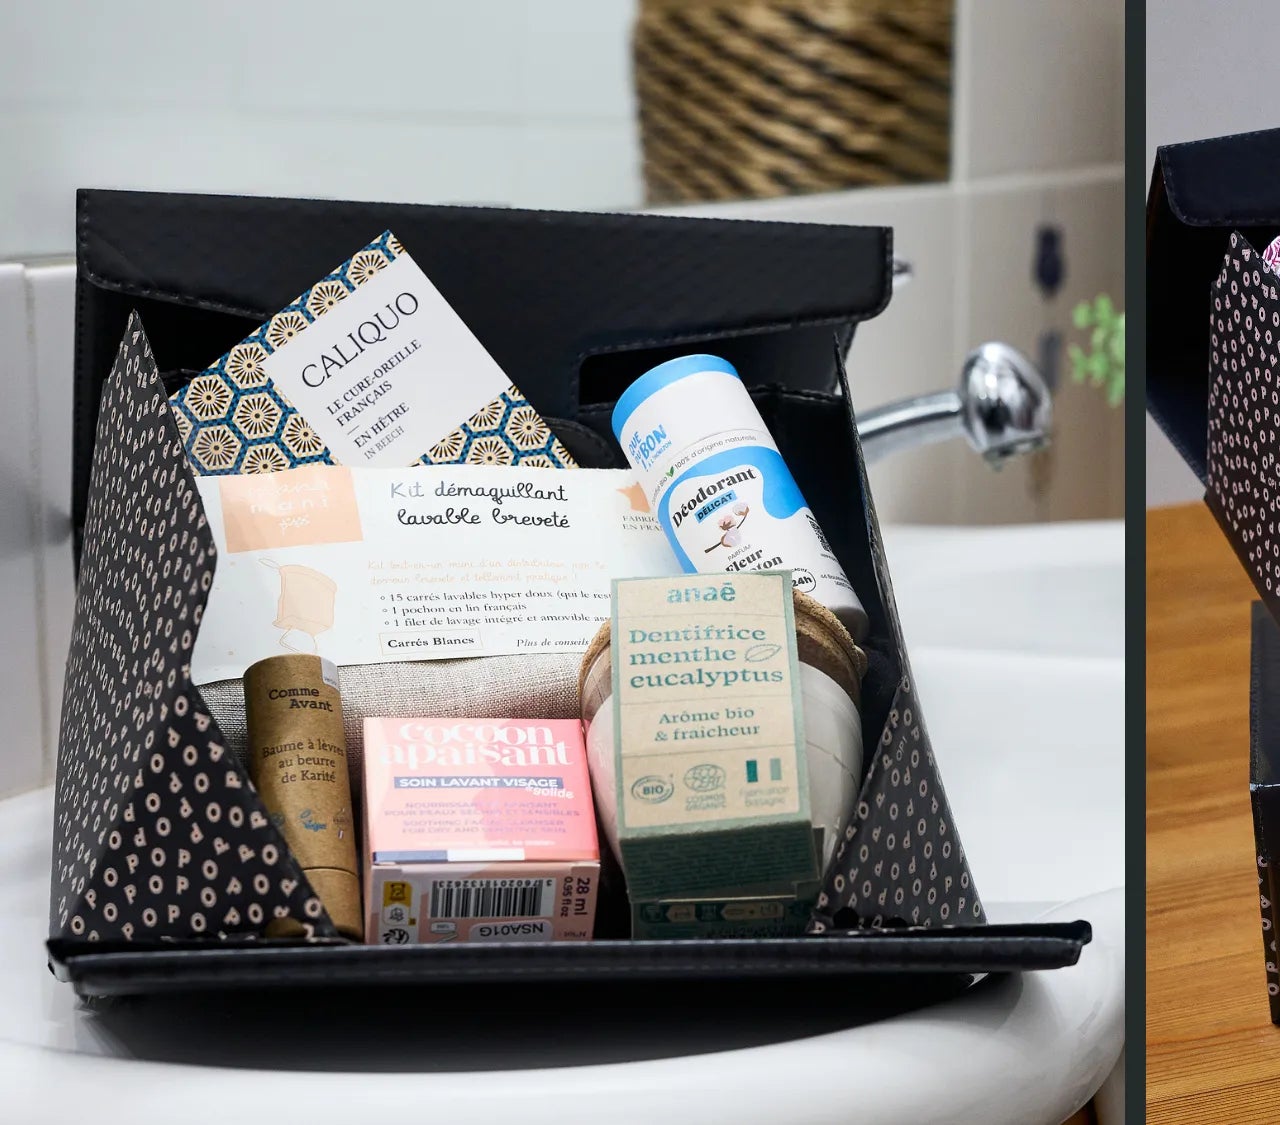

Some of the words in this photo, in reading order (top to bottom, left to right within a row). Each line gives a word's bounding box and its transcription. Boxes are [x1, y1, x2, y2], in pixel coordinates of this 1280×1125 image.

[302, 292, 419, 388] CALIQUO
[326, 399, 344, 416] LE
[343, 339, 422, 402] CURE-OREILLE
[336, 380, 393, 427] FRANÇAIS
[353, 429, 373, 448] EN
[370, 401, 410, 436] HÊTRE
[371, 425, 405, 453] BEECH
[640, 424, 667, 460] BON
[390, 482, 424, 498] Kit
[434, 480, 568, 505] démaquillant
[672, 468, 757, 528] Déodorant
[697, 493, 734, 520] DÉLICAT
[397, 507, 482, 525] lavable
[492, 507, 571, 528] breveté
[525, 589, 552, 599] doux
[402, 605, 445, 617] pochon
[484, 602, 527, 614] français
[387, 638, 429, 649] Carrés
[433, 637, 475, 647] Blancs
[629, 625, 766, 644] Dentifrice
[629, 646, 737, 666] menthe
[630, 668, 783, 688] eucalyptus
[269, 687, 320, 701] Comme
[289, 699, 333, 713] Avant
[659, 710, 720, 725] Arôme
[725, 707, 755, 720] bio
[401, 722, 554, 745] cocoon
[262, 739, 304, 758] Baume
[278, 759, 293, 769] au
[297, 755, 336, 768] beurre
[281, 772, 296, 784] de
[301, 770, 336, 784] Karité
[399, 778, 437, 788] SOIN
[440, 778, 502, 788] LAVANT
[503, 778, 559, 788] VISAGE
[576, 877, 591, 895] 28
[573, 899, 588, 916] ml
[479, 923, 544, 937] NSA01G
